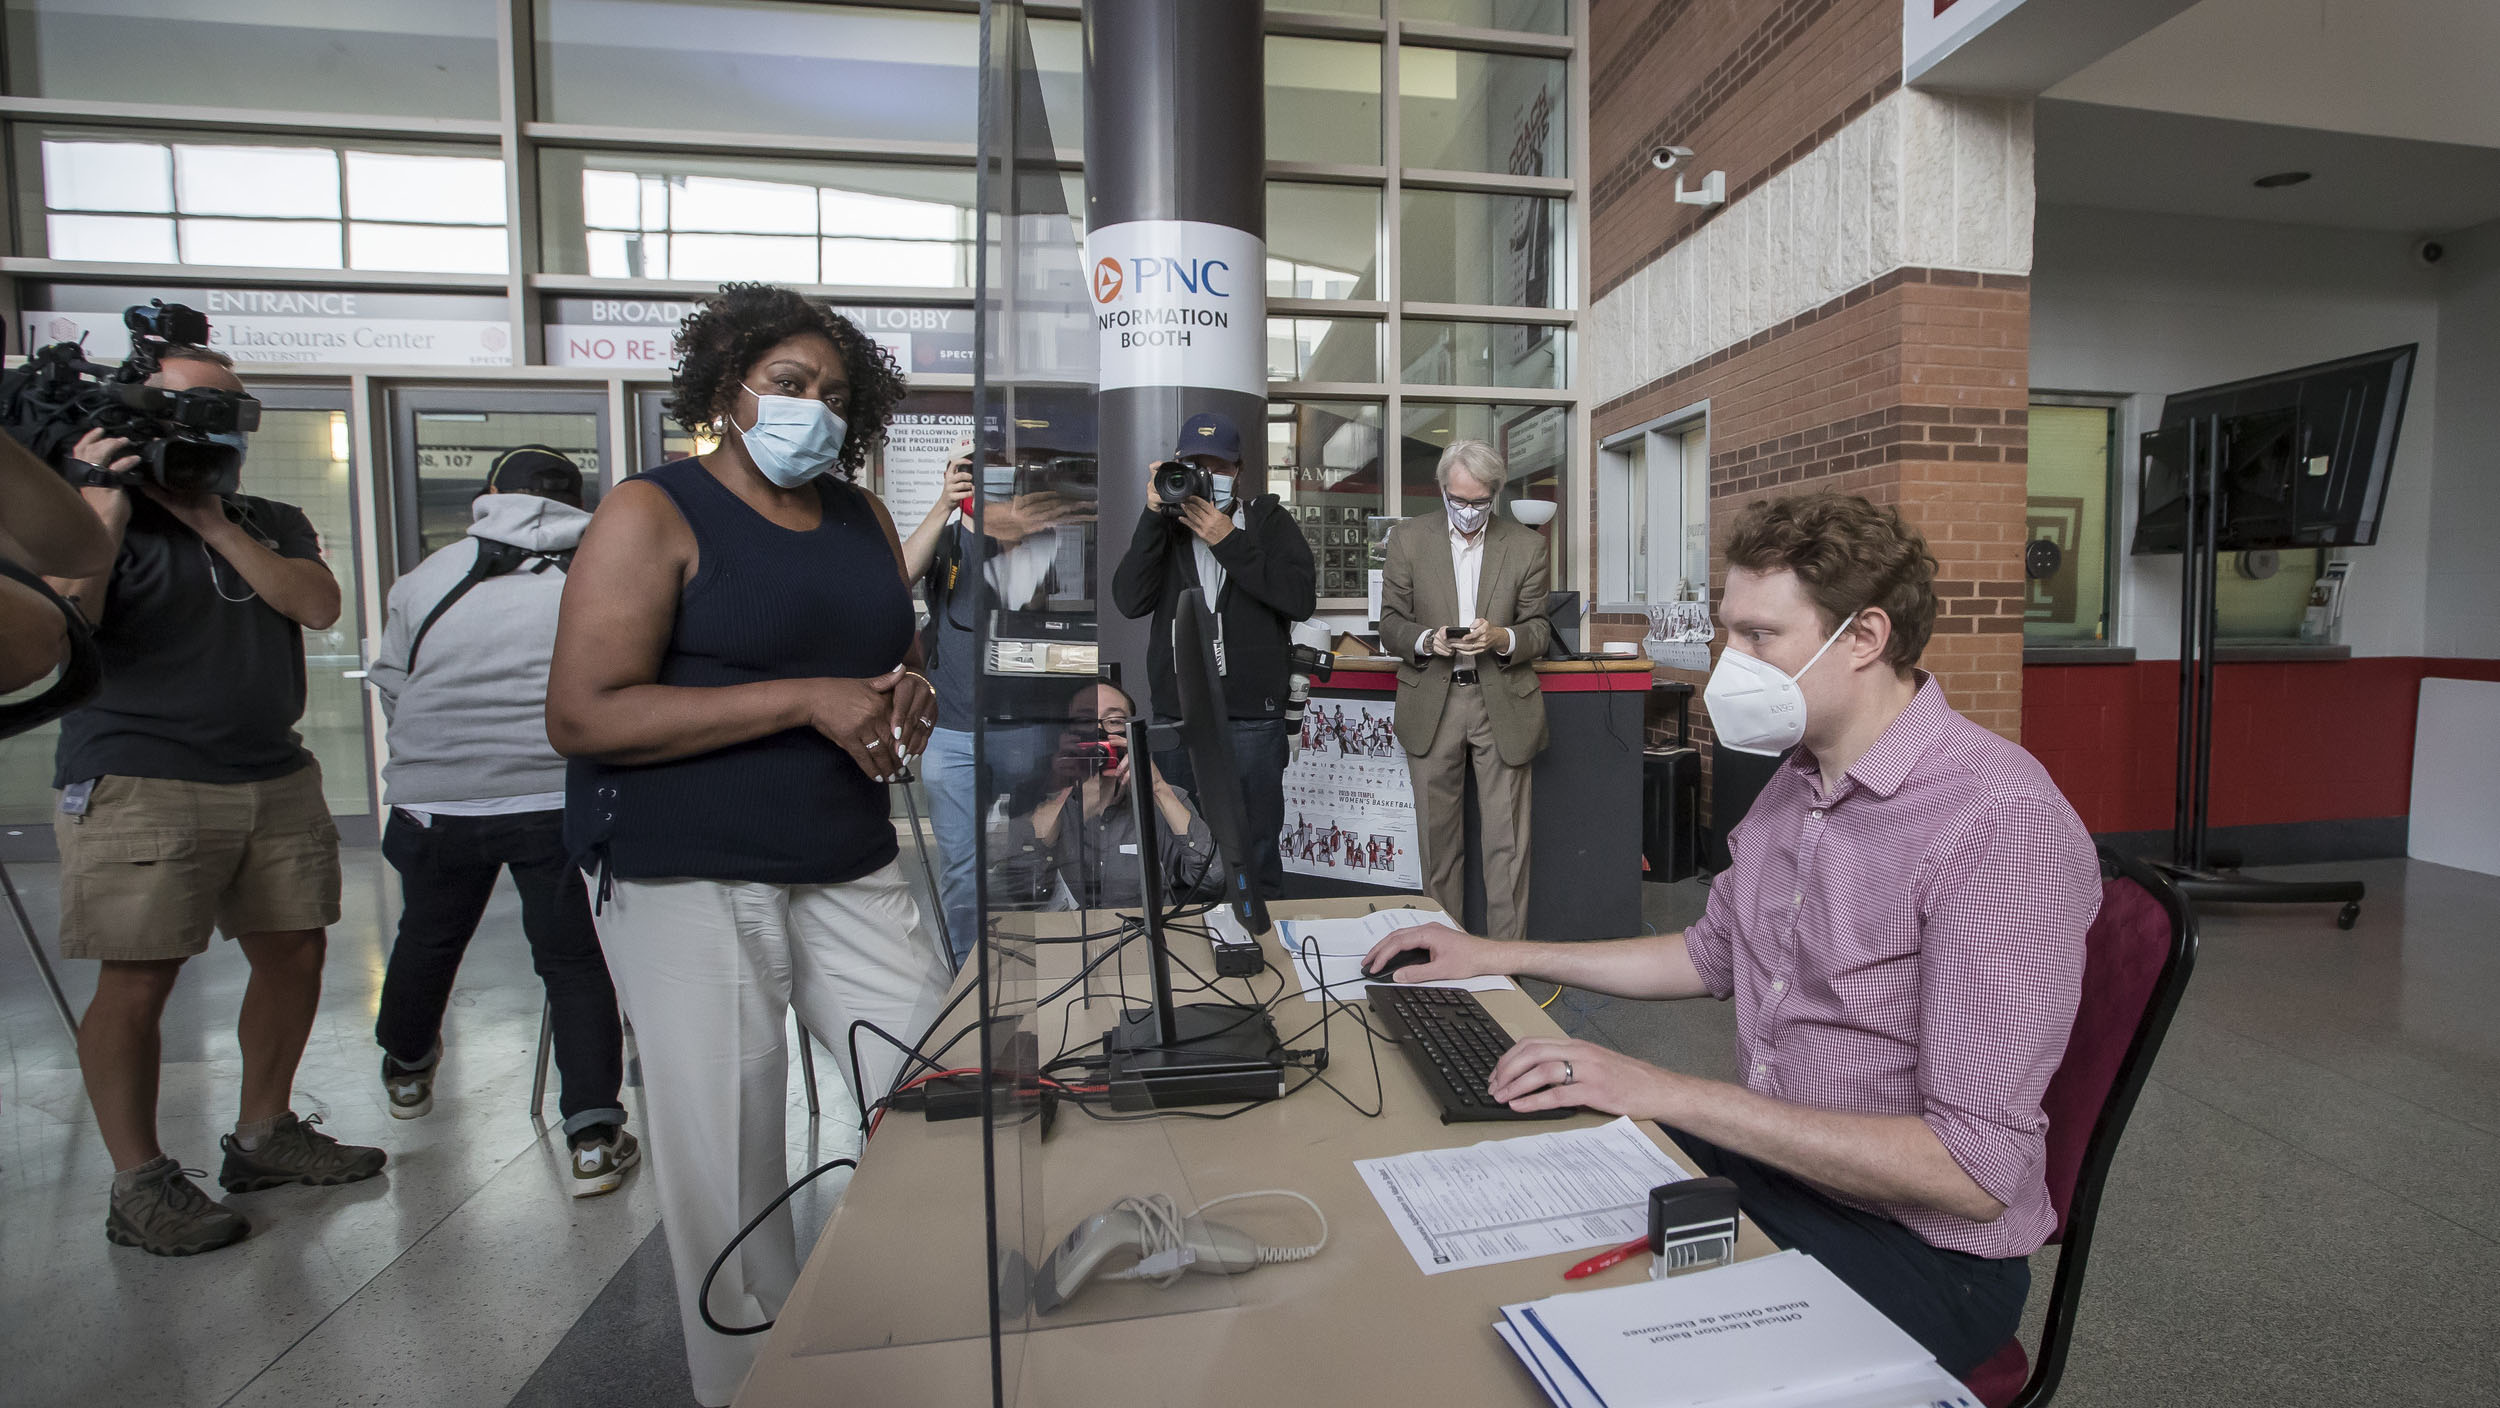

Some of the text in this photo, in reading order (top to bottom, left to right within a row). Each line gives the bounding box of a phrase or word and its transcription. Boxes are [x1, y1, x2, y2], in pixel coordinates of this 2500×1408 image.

[1130, 257, 1230, 297] PNC
[206, 291, 357, 315] ENTRANCE
[591, 301, 680, 322] BROAD
[876, 308, 952, 329] LOBBY
[1099, 308, 1228, 331] NFORMATION
[229, 325, 347, 348] Liacouras
[353, 327, 435, 349] Center
[1121, 330, 1191, 348] BOOTH
[569, 339, 681, 361] NO RE-E
[940, 350, 994, 359] SPECT
[892, 414, 918, 425] ULES
[920, 414, 936, 425] OF
[938, 414, 977, 425] COND
[445, 455, 473, 467] 107
[1339, 796, 1370, 805] WOMEN'S
[1622, 1300, 1810, 1338] Boleta Oficial de Elecciones
[1649, 1313, 1803, 1345] Official Election Ballot
